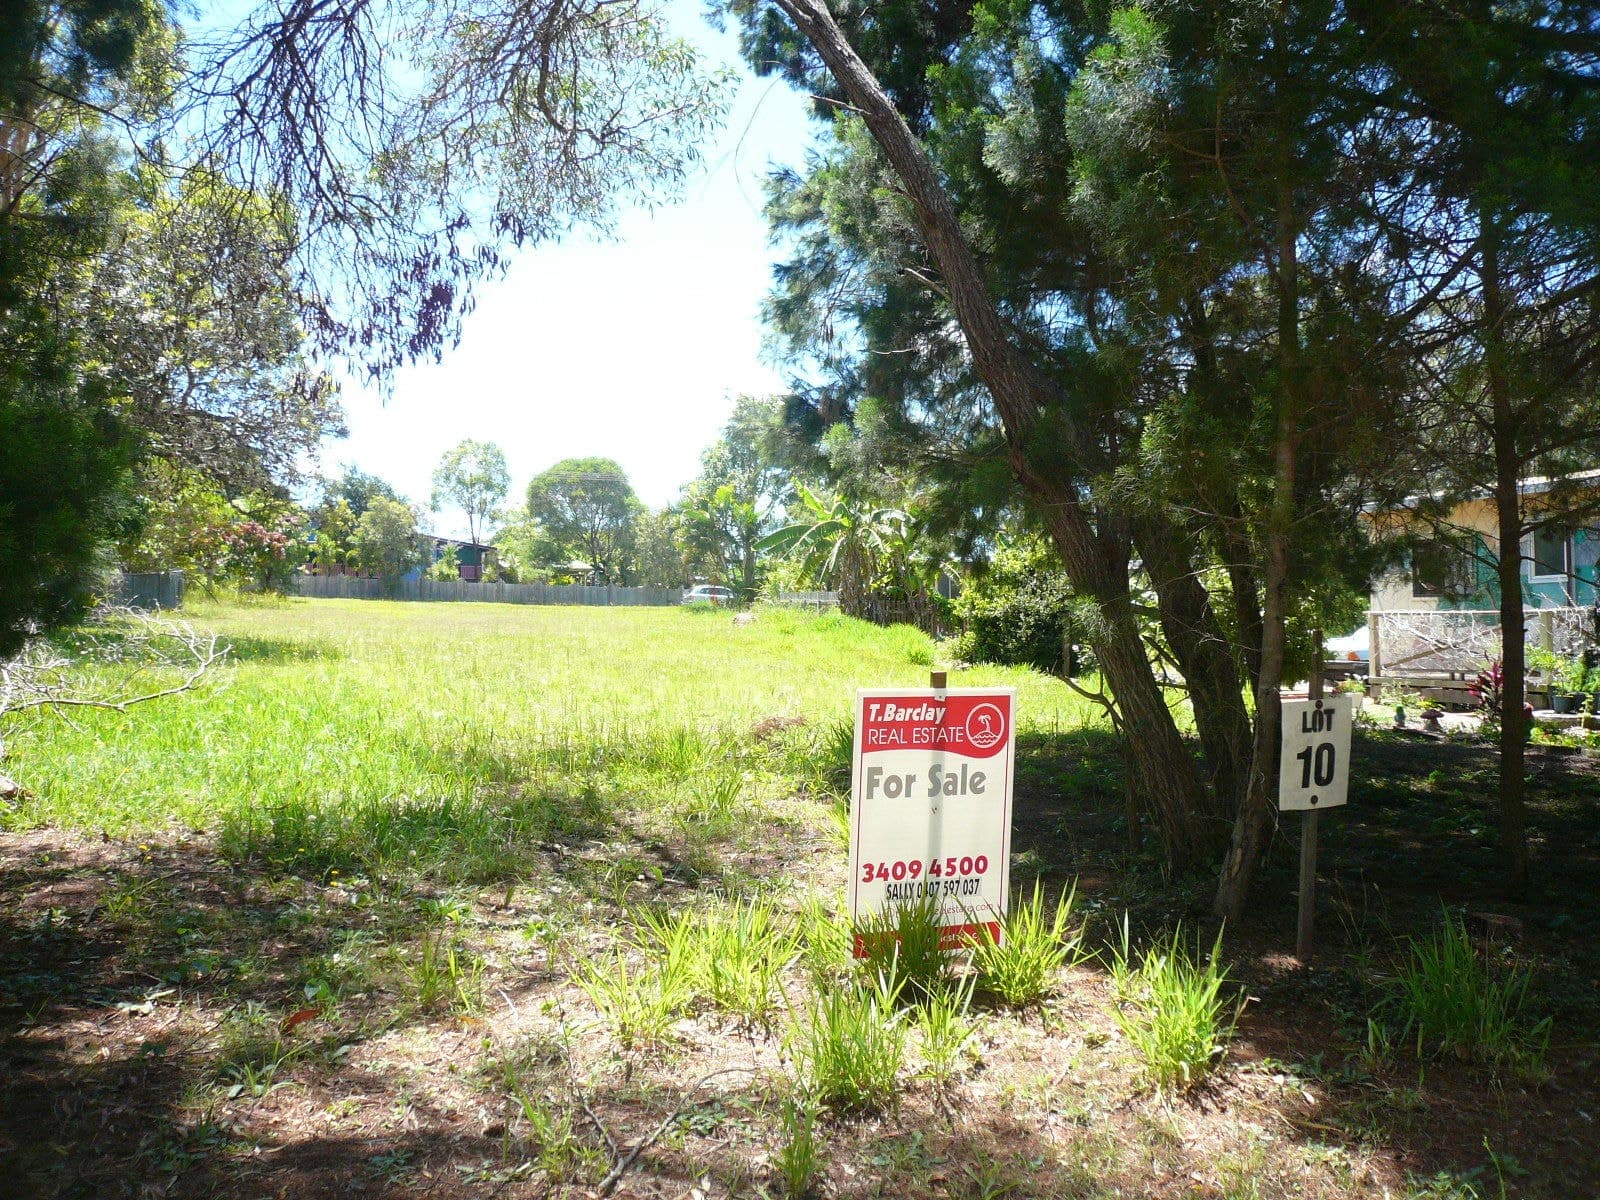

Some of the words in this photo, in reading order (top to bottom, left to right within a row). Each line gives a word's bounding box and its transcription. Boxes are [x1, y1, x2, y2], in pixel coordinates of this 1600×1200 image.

[869, 703, 946, 724] T.Barclay
[1302, 708, 1336, 733] LOT
[868, 728, 908, 745] REAL
[912, 726, 964, 744] ESTATE
[1296, 742, 1336, 788] 10
[866, 766, 917, 800] For
[927, 763, 987, 798] Sale
[862, 859, 923, 883] 3409
[928, 855, 989, 877] 4500
[887, 882, 914, 900] SALLY
[943, 880, 960, 897] 597
[962, 879, 980, 895] 037
